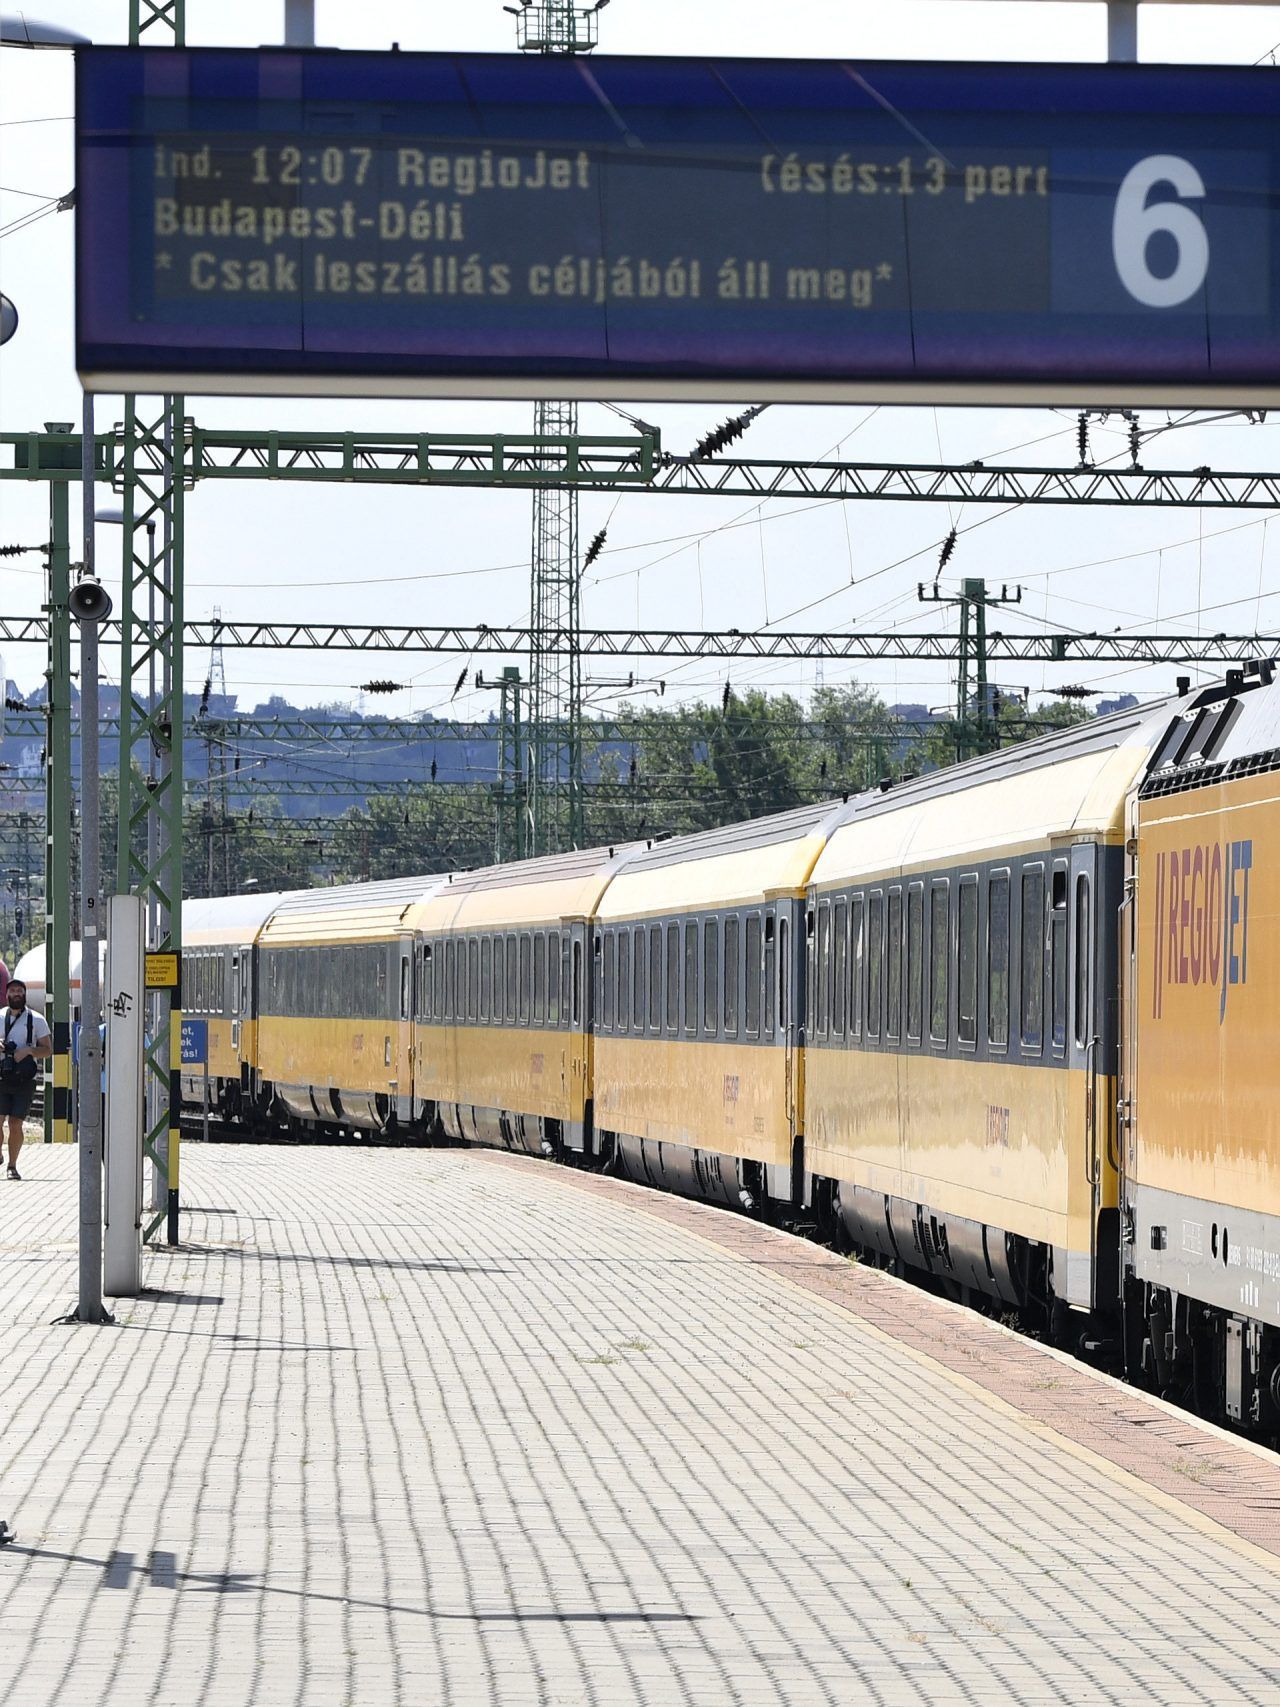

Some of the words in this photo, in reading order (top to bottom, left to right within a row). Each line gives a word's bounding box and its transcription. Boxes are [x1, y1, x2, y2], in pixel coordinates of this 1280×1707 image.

[252, 146, 373, 185] 12:07
[398, 148, 590, 196] RegioJet
[155, 198, 465, 245] Budapest-Déli
[1112, 154, 1210, 308] 6
[189, 251, 298, 291] Csak
[314, 252, 511, 296] leszállás
[528, 254, 700, 303] céljából
[718, 257, 770, 299] áll
[87, 898, 95, 909] 9
[1167, 839, 1253, 1026] REGIOJET
